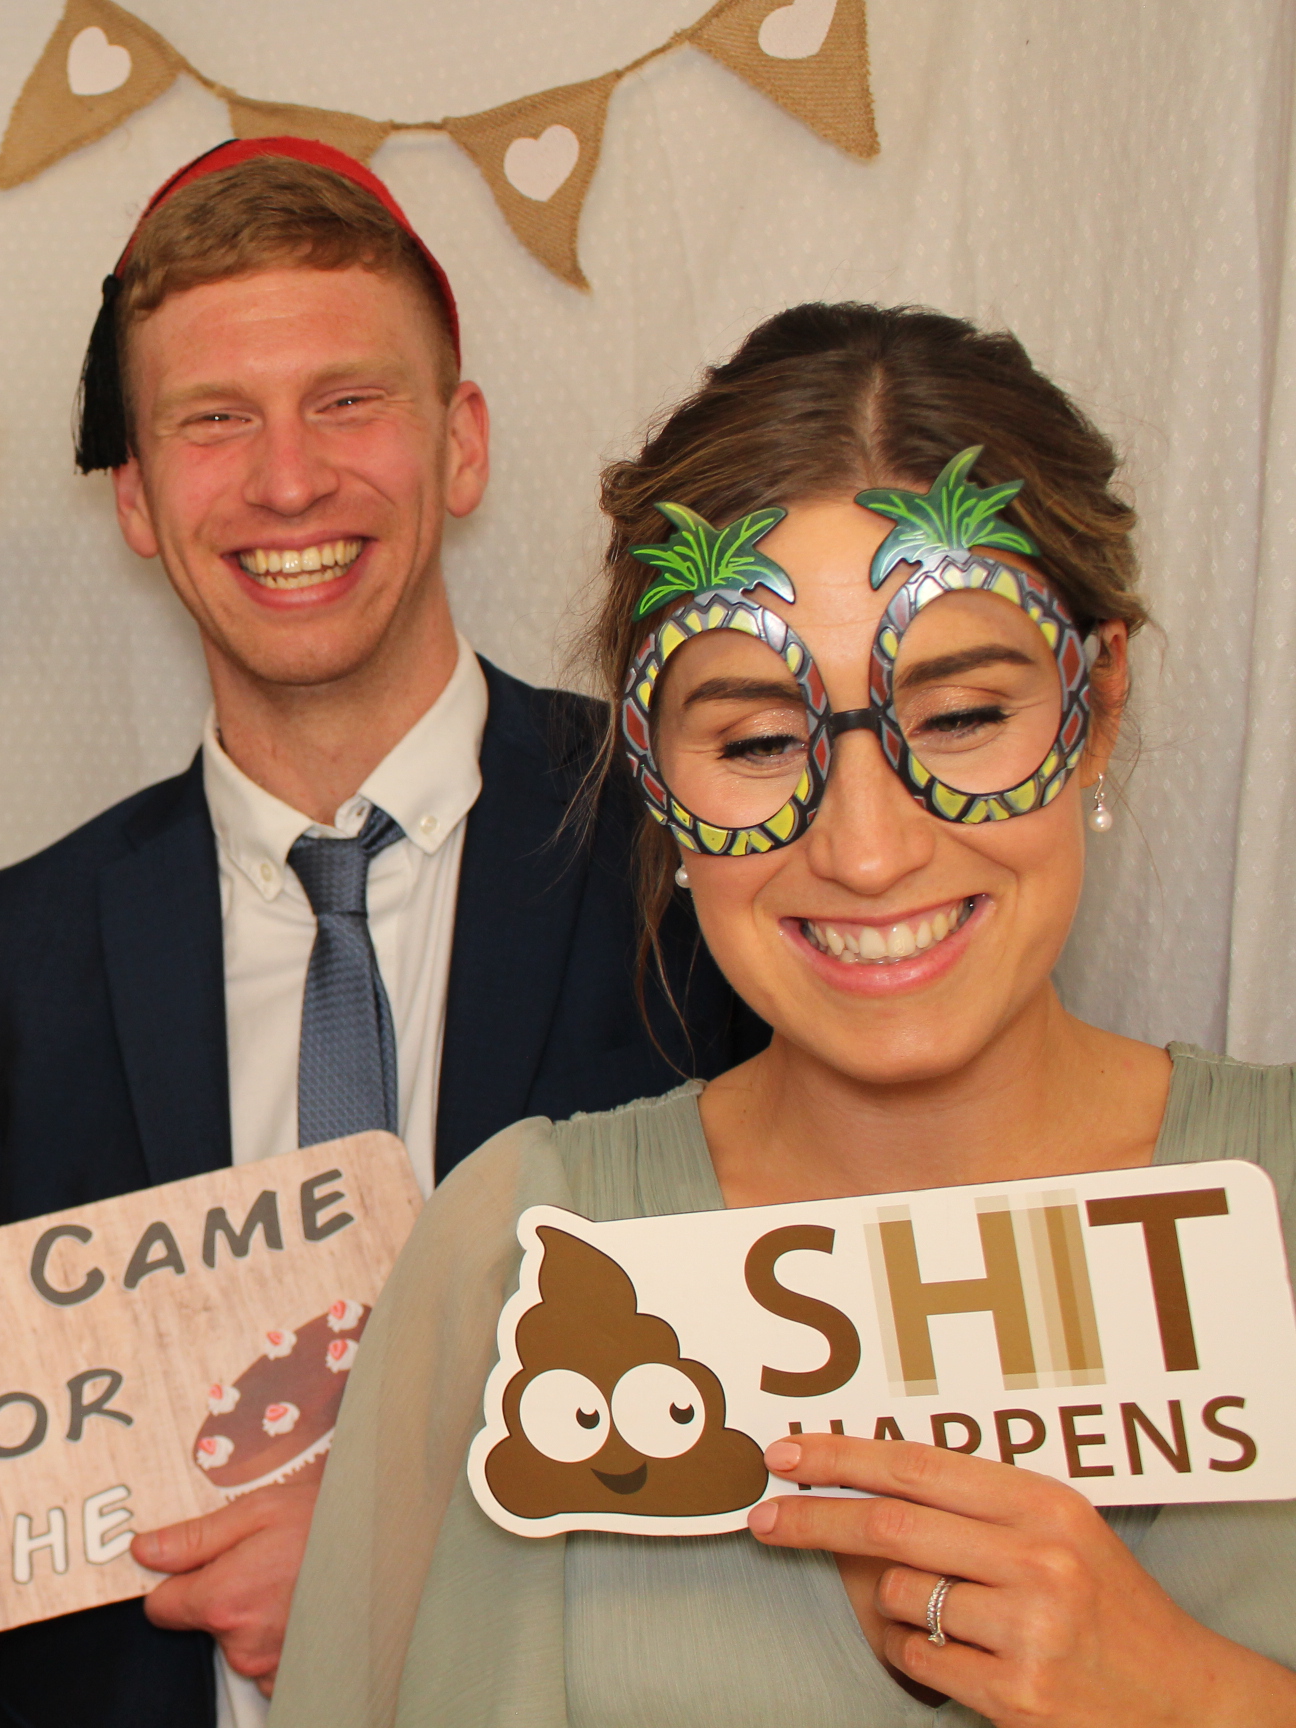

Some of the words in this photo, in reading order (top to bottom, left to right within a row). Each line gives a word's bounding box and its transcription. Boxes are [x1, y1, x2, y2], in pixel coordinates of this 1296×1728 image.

[30, 1168, 355, 1307] CAME
[743, 1187, 1230, 1398] SHIT
[787, 1394, 1259, 1491] PPENS
